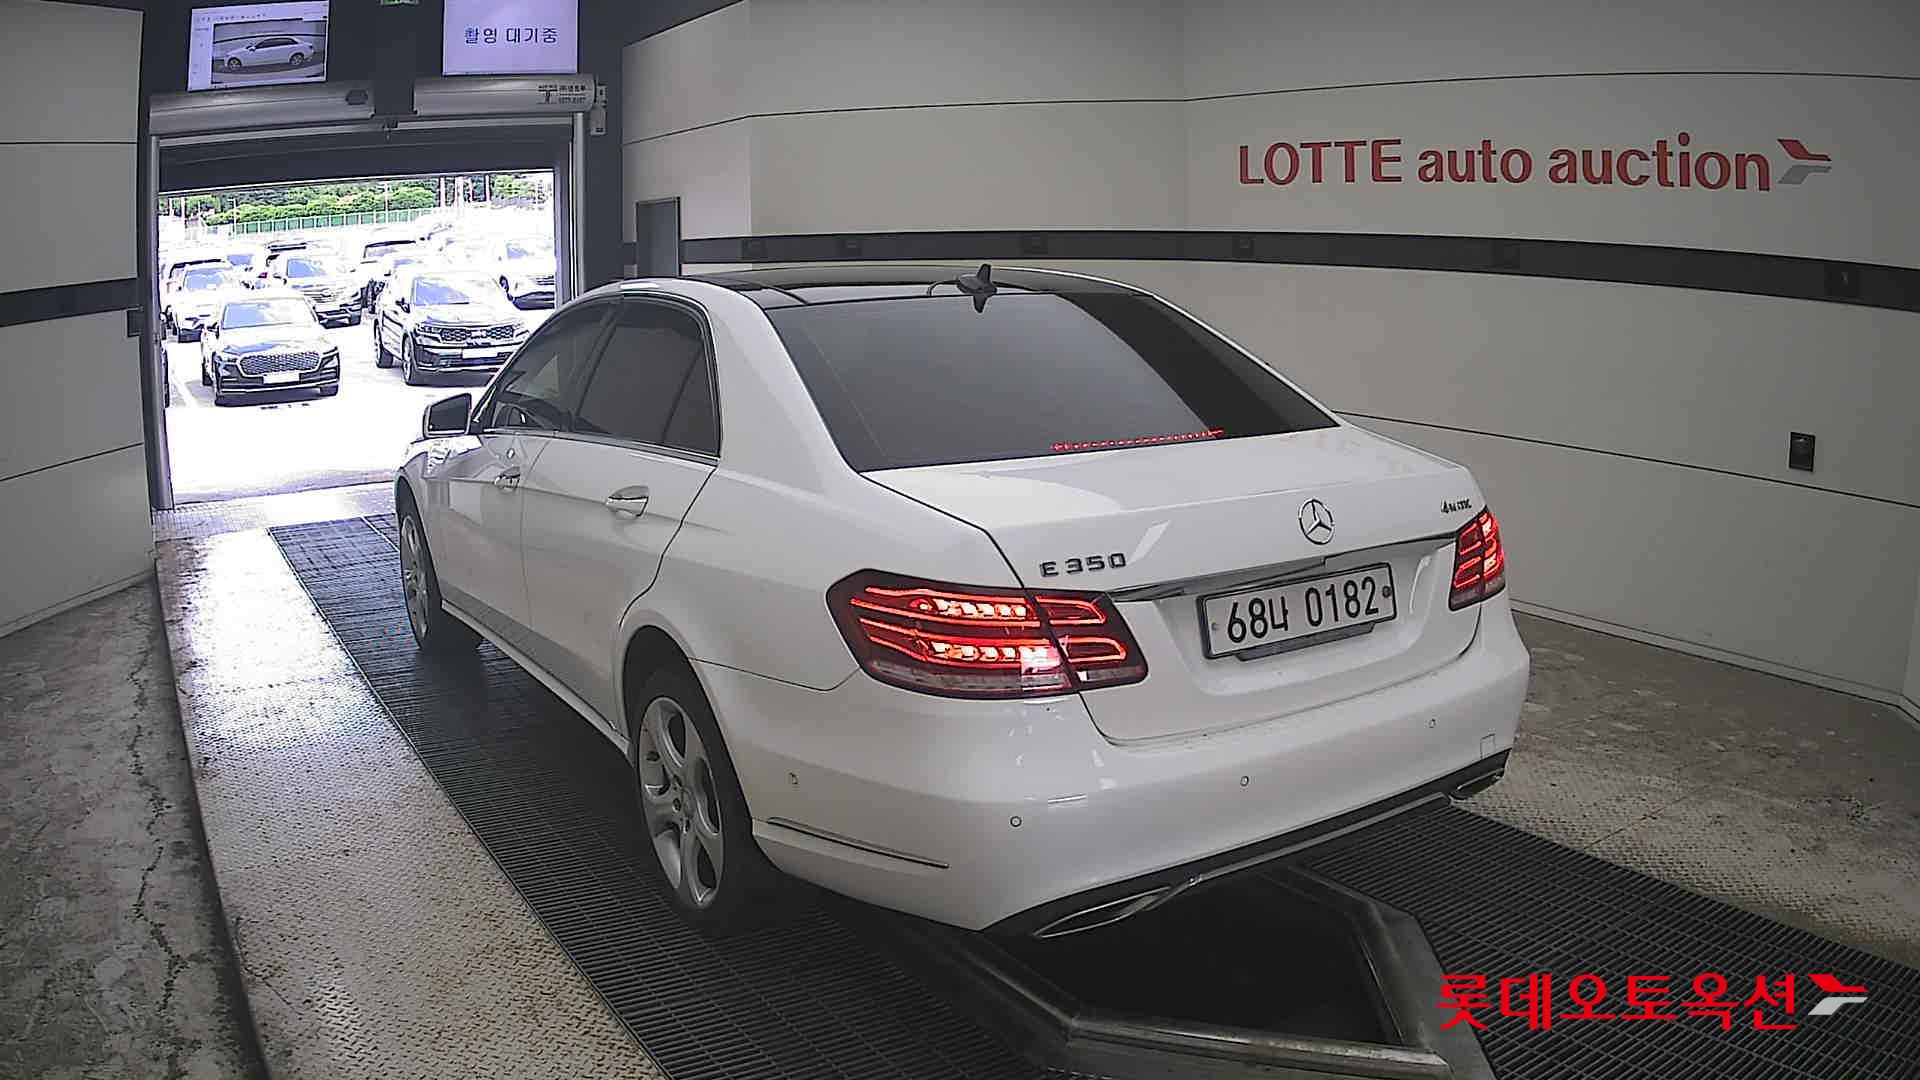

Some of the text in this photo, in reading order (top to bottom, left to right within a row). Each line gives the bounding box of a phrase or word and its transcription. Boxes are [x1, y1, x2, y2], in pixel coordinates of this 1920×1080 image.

[464, 27, 558, 44] 촬영 대기중
[1239, 132, 1770, 192] LOTTE auto auction
[1040, 552, 1127, 578] E 350
[1227, 575, 1378, 644] 68나 0182
